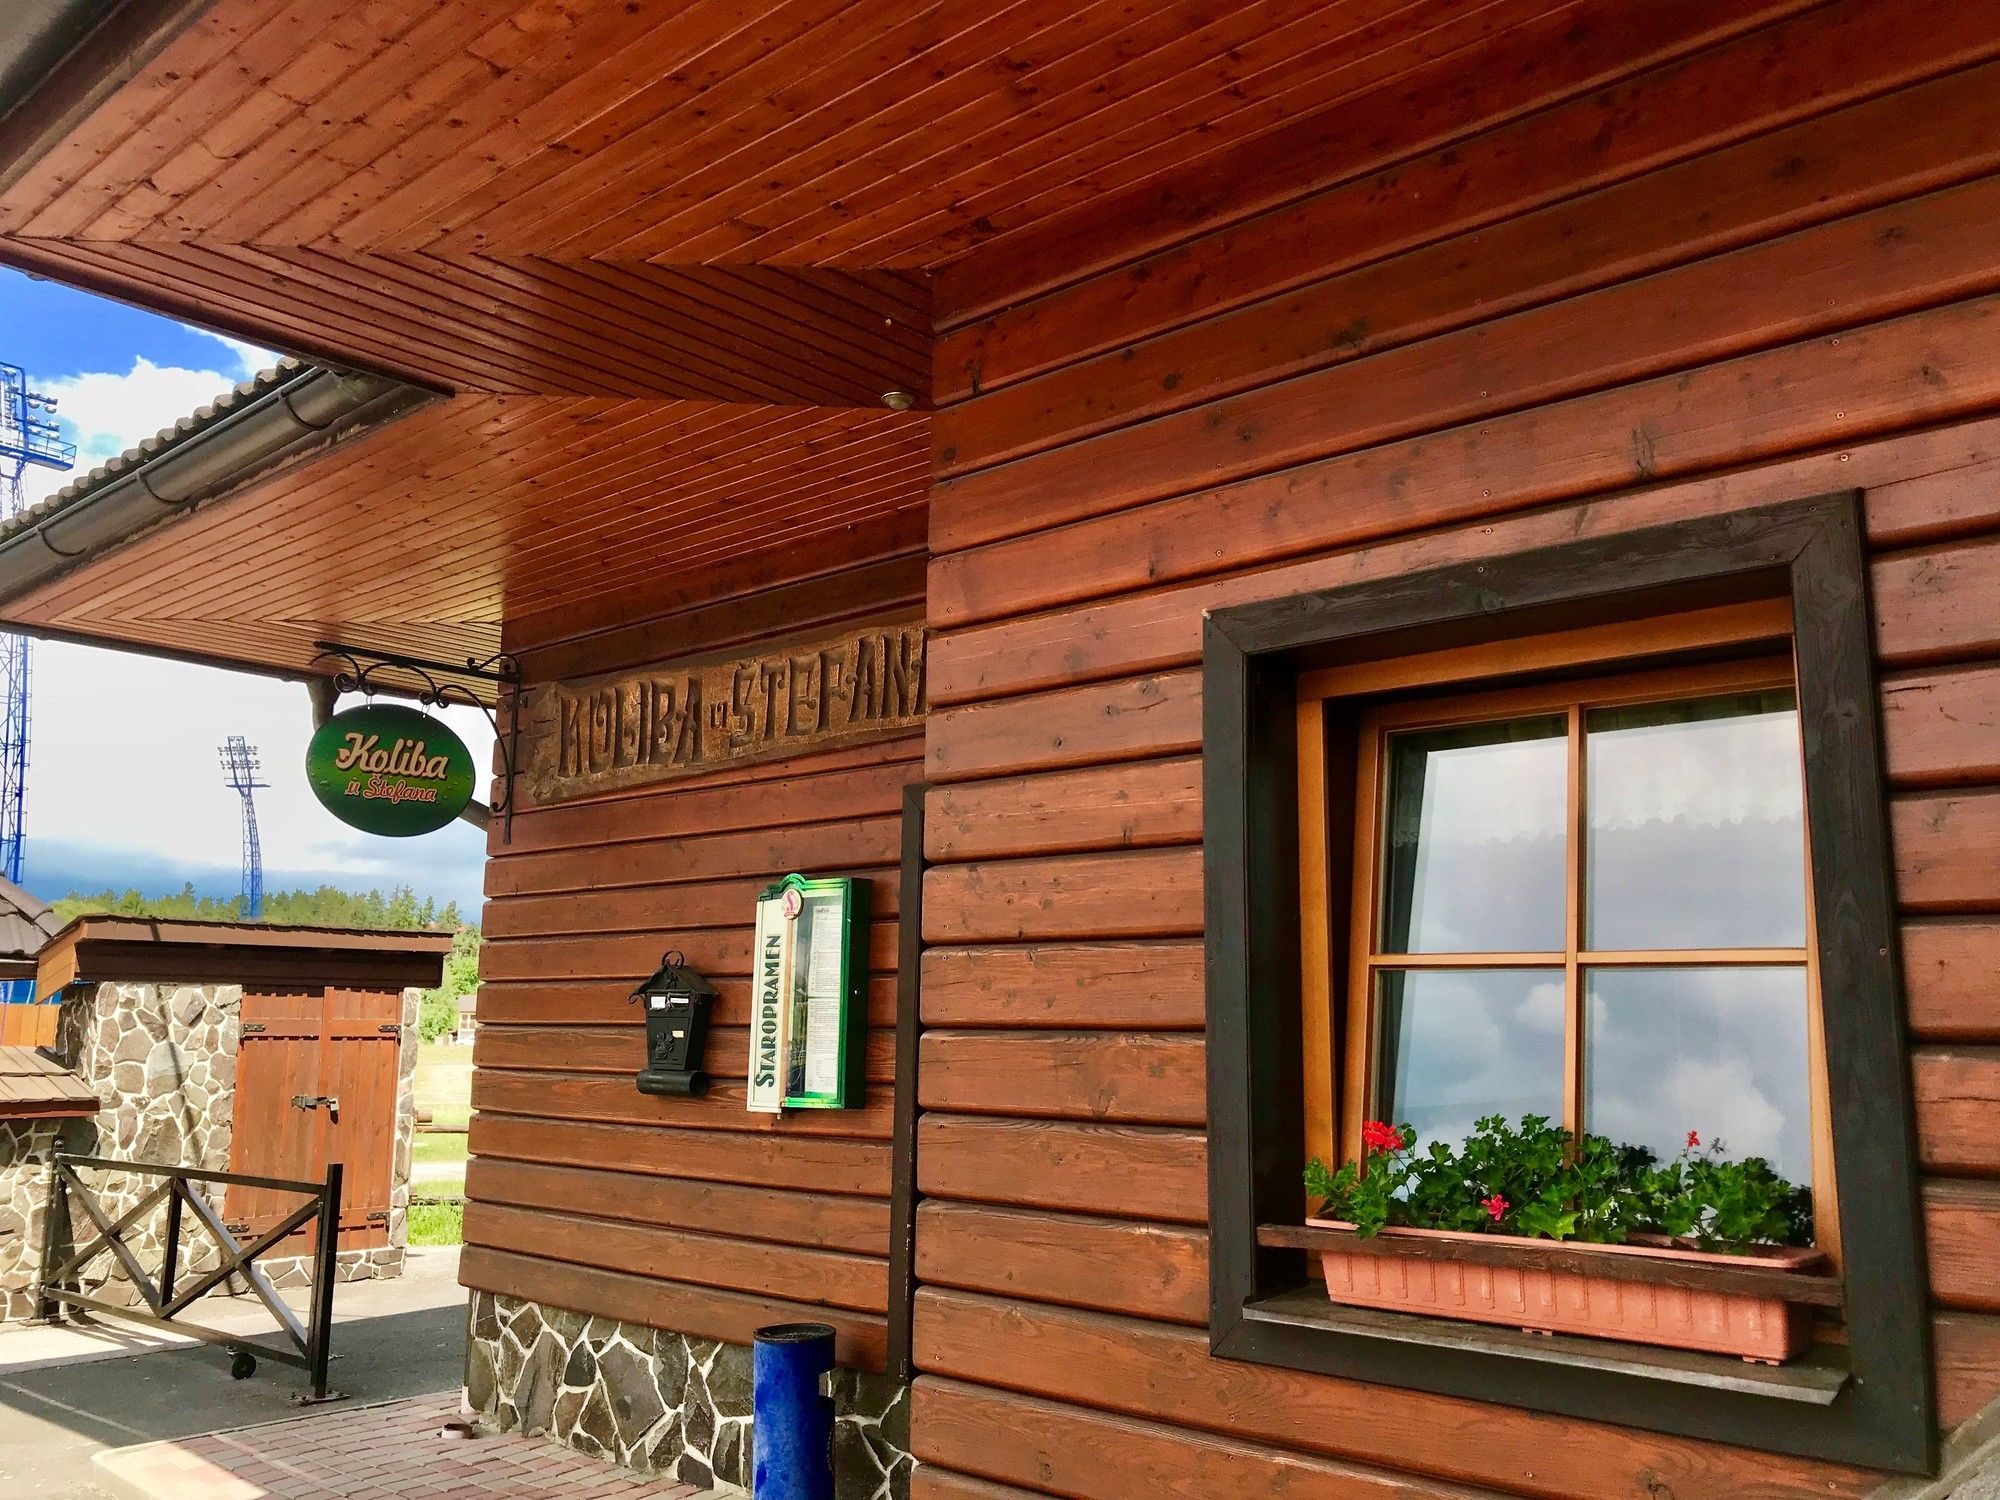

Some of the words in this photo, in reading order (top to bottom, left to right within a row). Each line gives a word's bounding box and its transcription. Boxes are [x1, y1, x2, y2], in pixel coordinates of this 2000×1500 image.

[335, 732, 450, 779] Koliba
[557, 677, 704, 779] KOLIBA
[344, 780, 361, 796] u
[362, 773, 437, 805] Štefana
[755, 934, 782, 1088] STAROPRAMEN
